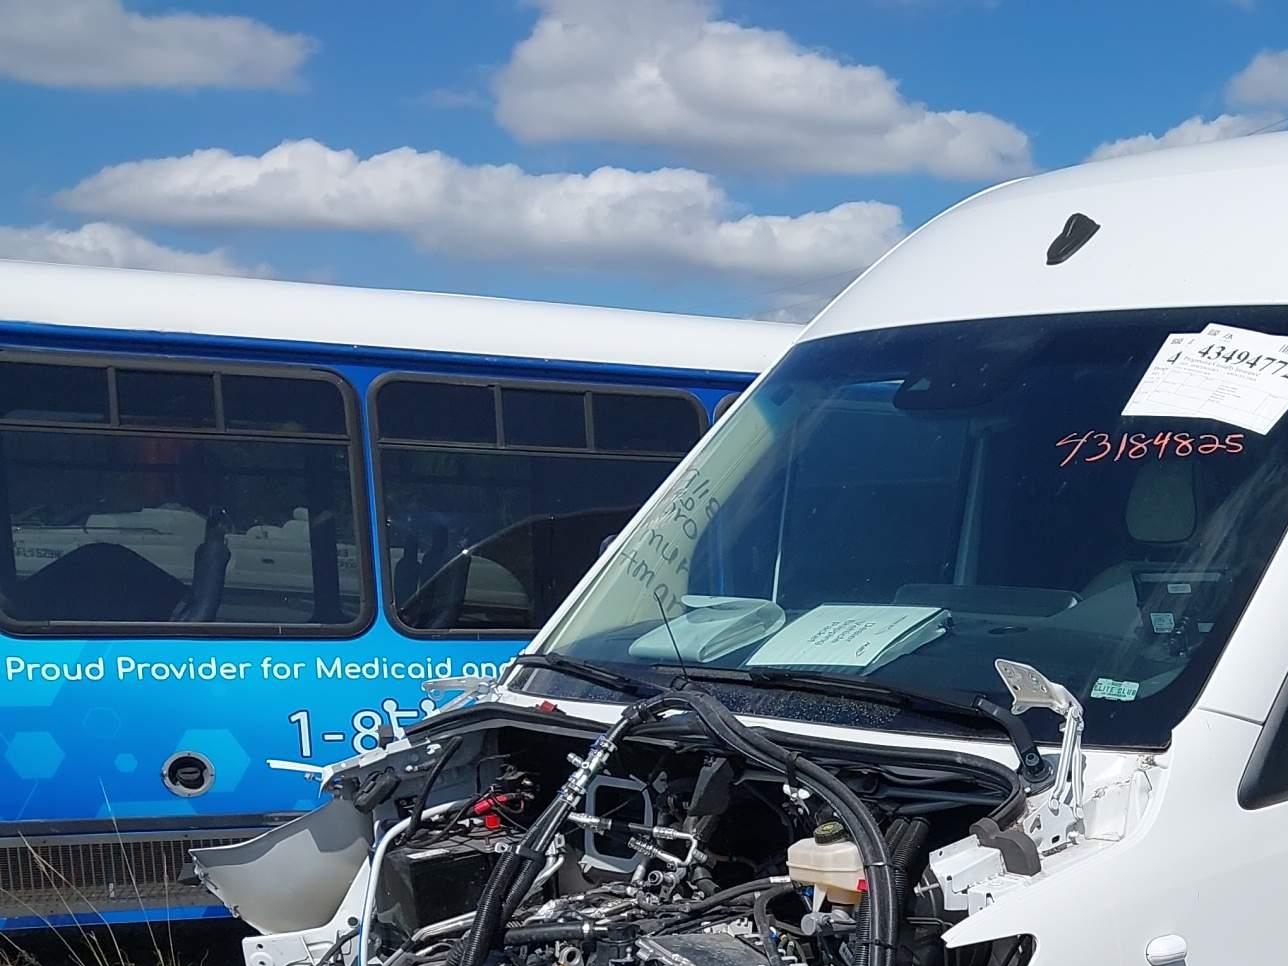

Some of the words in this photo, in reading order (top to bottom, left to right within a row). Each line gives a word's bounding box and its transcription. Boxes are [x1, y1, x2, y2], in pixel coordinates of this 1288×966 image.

[1056, 431, 1245, 467] 43184825
[5, 656, 106, 681] Proud
[116, 656, 252, 680] Provider
[261, 656, 306, 680] for
[315, 656, 452, 680] Medicaid
